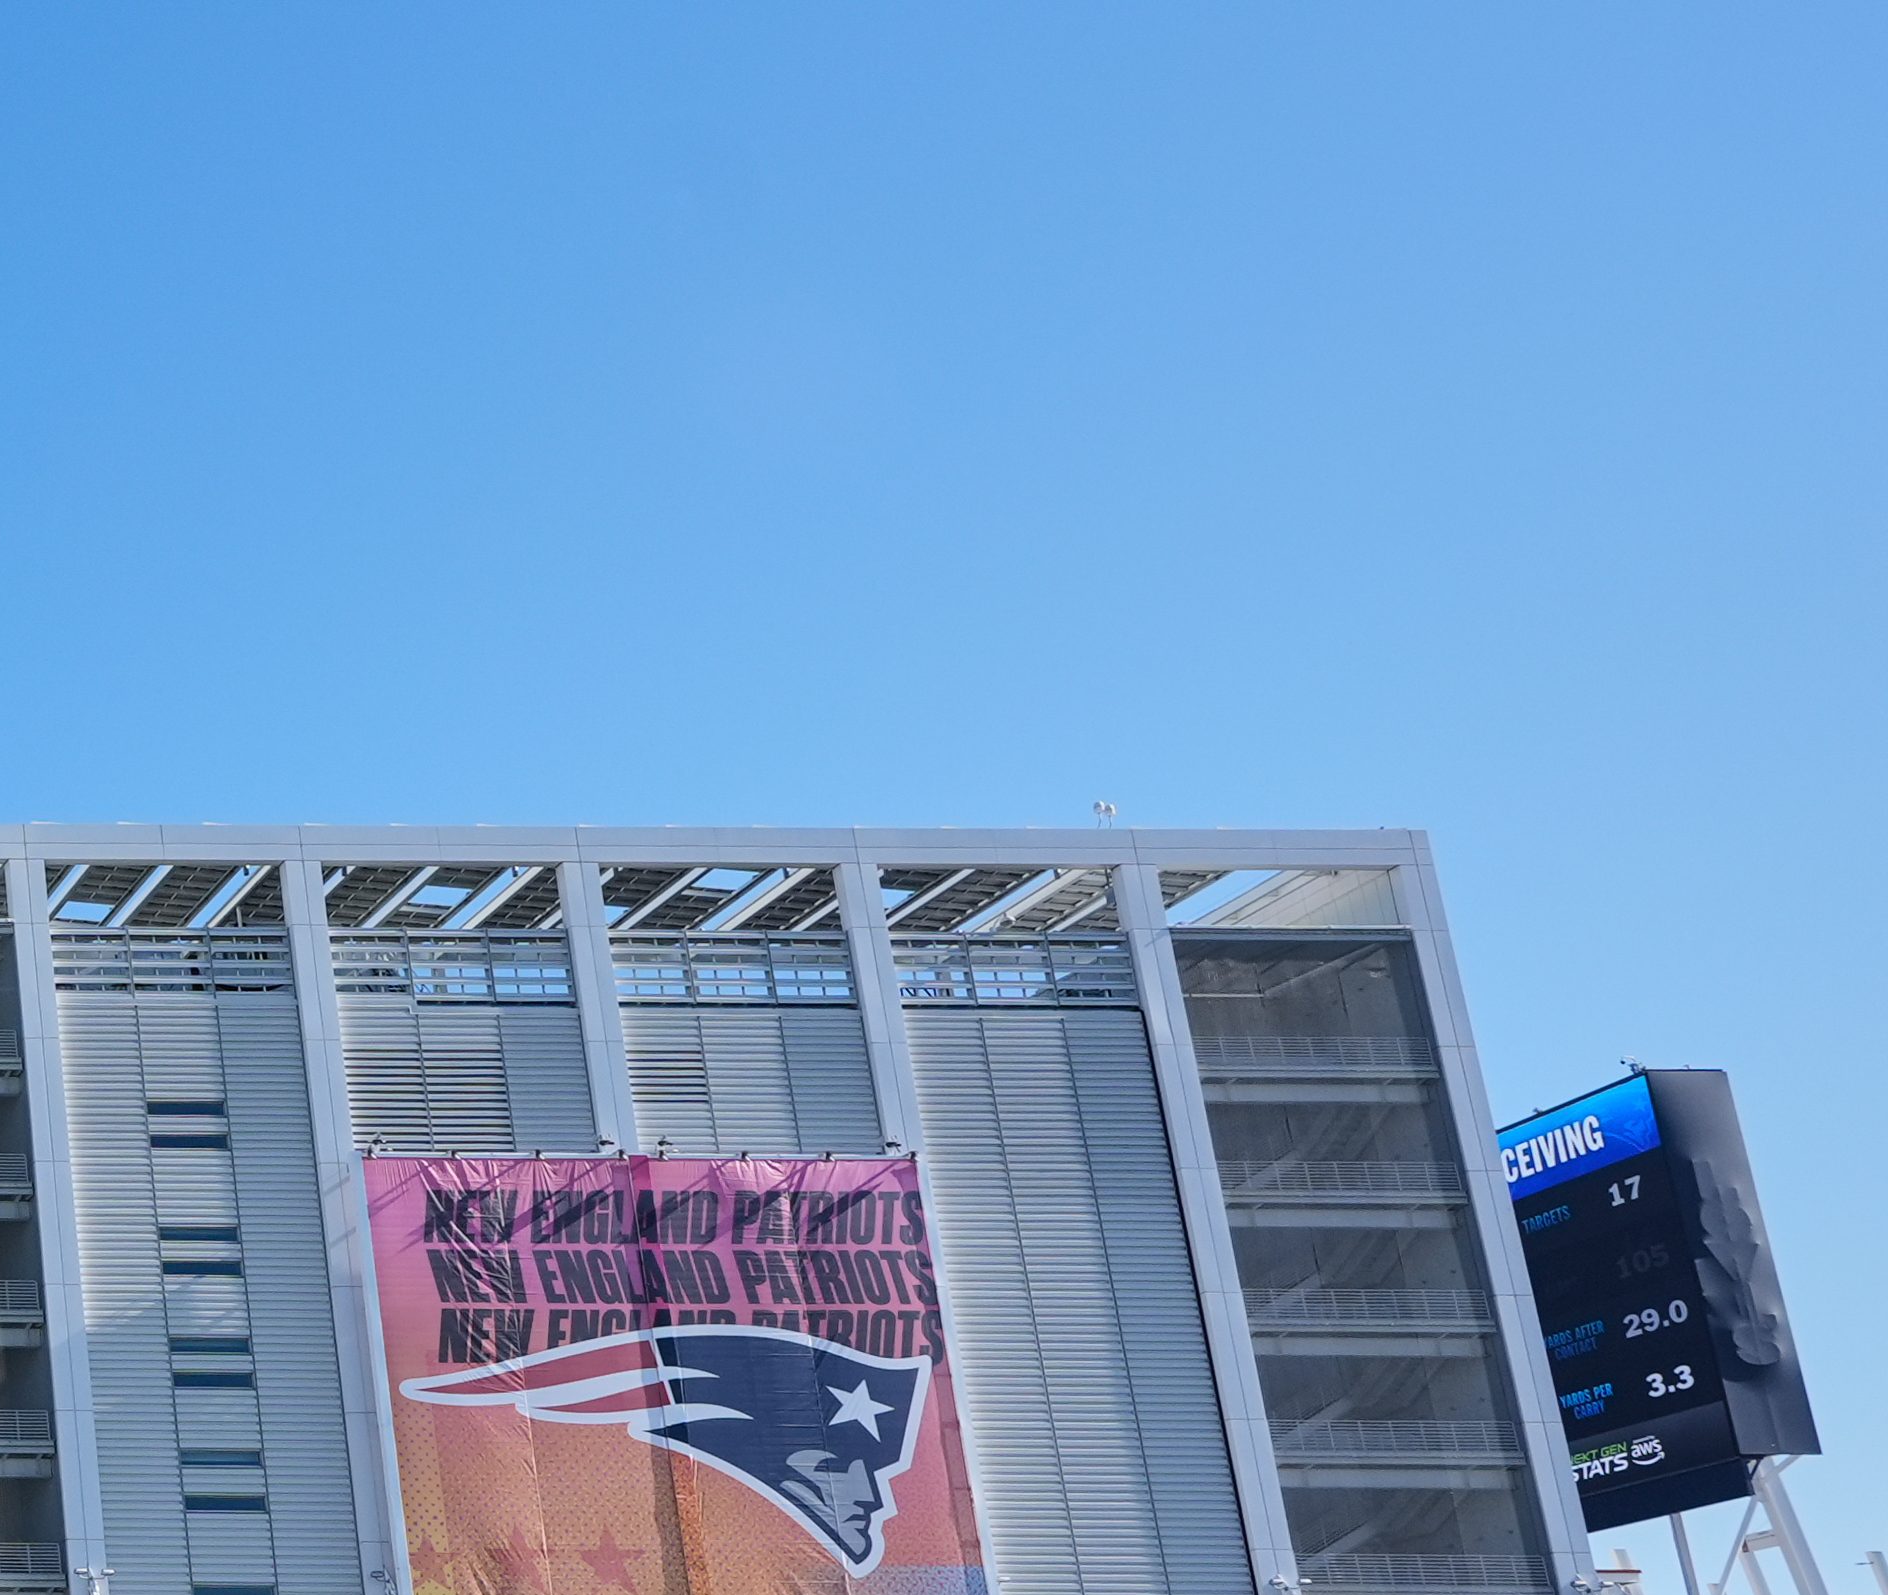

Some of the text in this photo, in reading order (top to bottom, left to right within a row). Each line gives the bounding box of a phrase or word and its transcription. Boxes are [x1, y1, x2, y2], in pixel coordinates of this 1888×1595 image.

[1500, 1115, 1605, 1183] CEIVING
[1608, 1175, 1641, 1207] 17
[423, 1189, 926, 1246] NEW ENGLAND PATRIOTS
[1522, 1205, 1572, 1235] TARGETS
[426, 1249, 940, 1306] NEW ENGLAND PATRIOTS
[1575, 1320, 1606, 1340] AFTER
[1623, 1299, 1689, 1338] 29.0
[438, 1308, 536, 1364] NEW
[752, 1309, 945, 1366] TRIOTS
[1555, 1338, 1598, 1360] CONTACT
[1559, 1383, 1615, 1409] YARDS PER
[1645, 1365, 1695, 1397] 3.3
[1574, 1400, 1606, 1420] CARRY
[1600, 1442, 1627, 1457] GEN
[1630, 1438, 1663, 1458] aws
